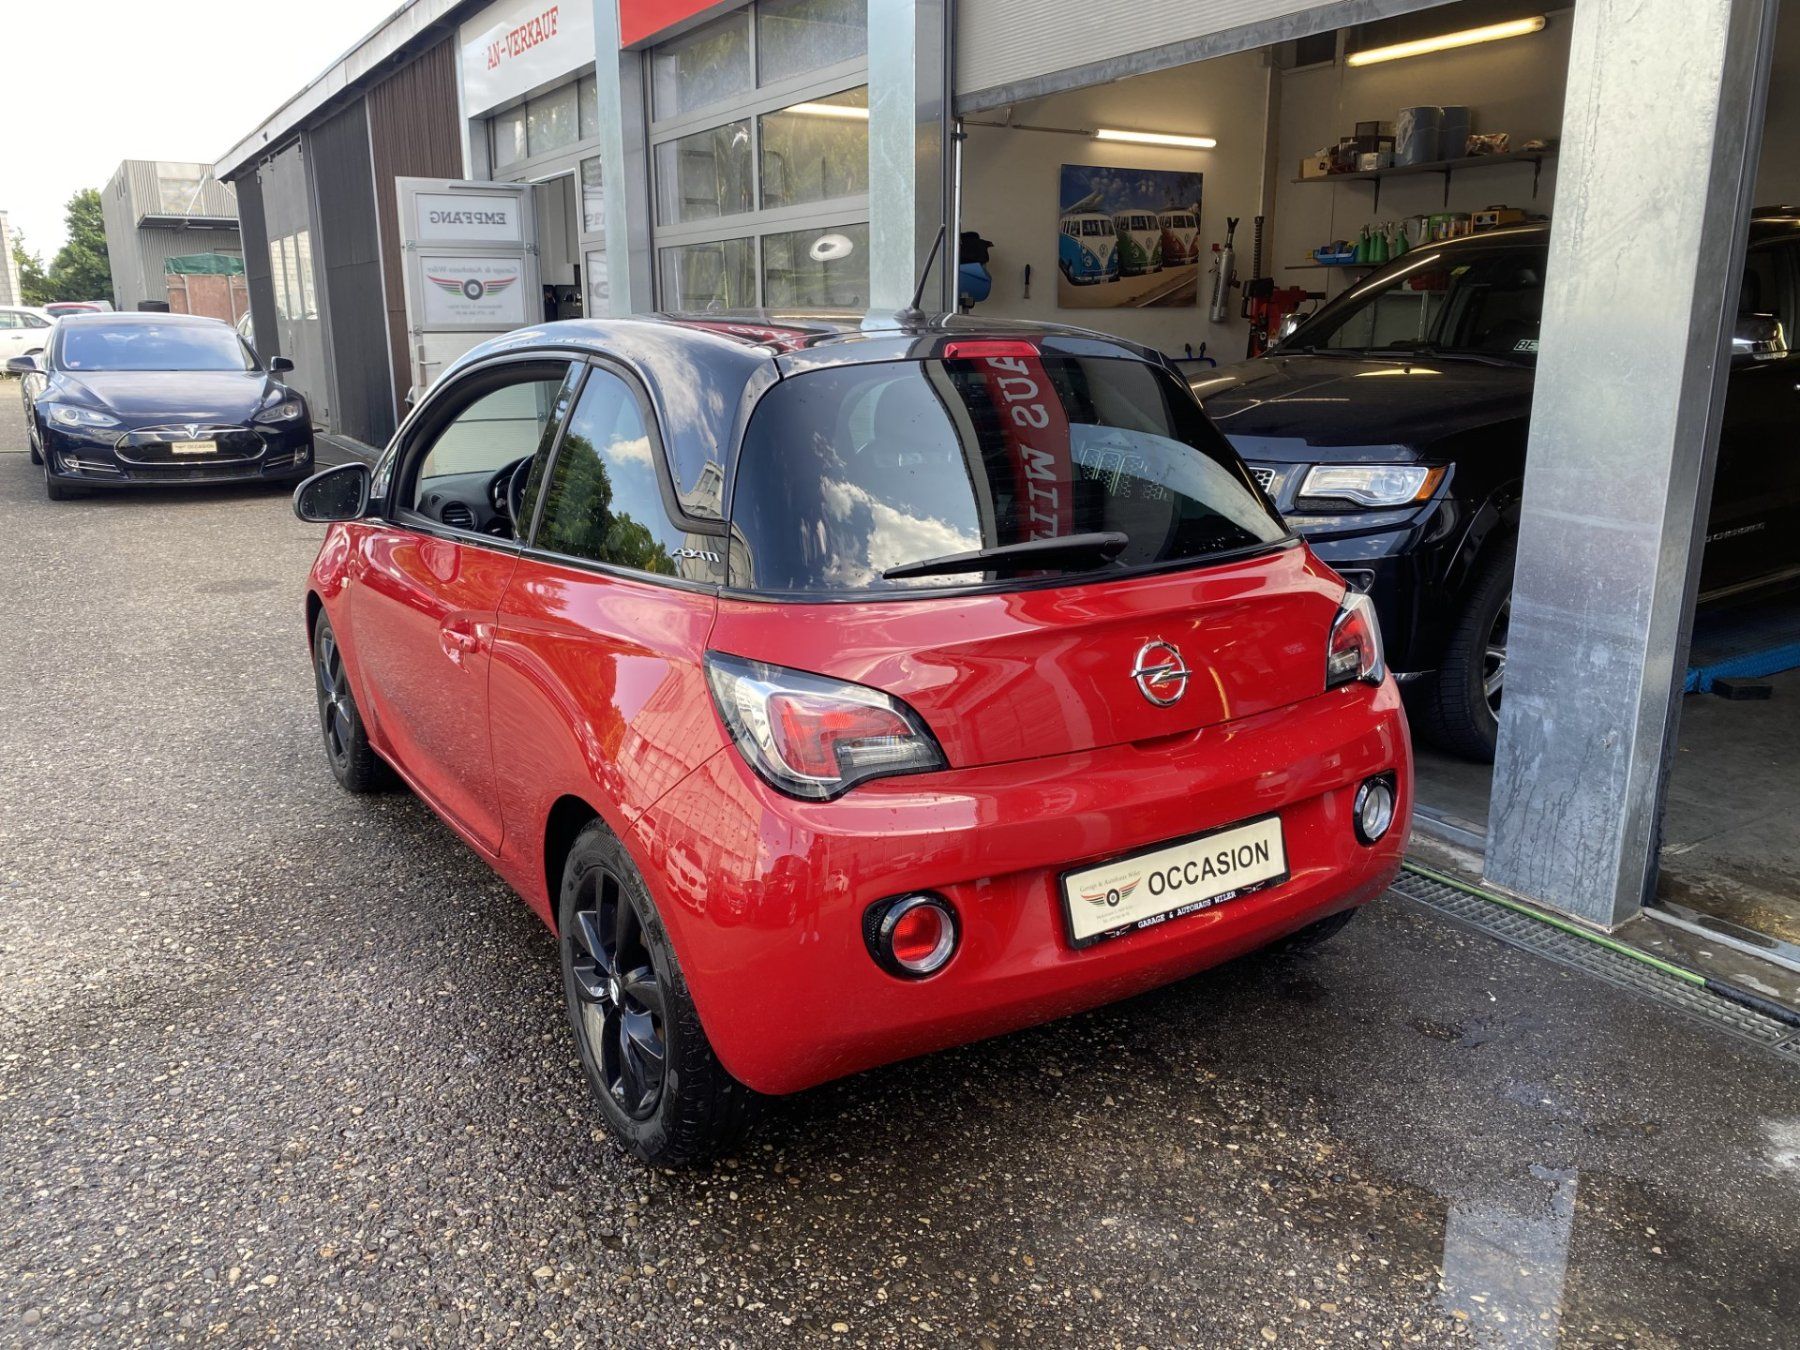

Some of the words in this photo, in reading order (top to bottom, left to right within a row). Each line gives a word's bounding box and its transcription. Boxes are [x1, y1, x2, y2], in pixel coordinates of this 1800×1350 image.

[488, 5, 558, 70] AN-VERKAUF
[1148, 839, 1270, 896] OCCASION
[1138, 913, 1165, 929] GARAGE
[1168, 911, 1174, 919] &
[1177, 899, 1211, 917] AUTOHAUS
[1214, 890, 1237, 904] WILER
